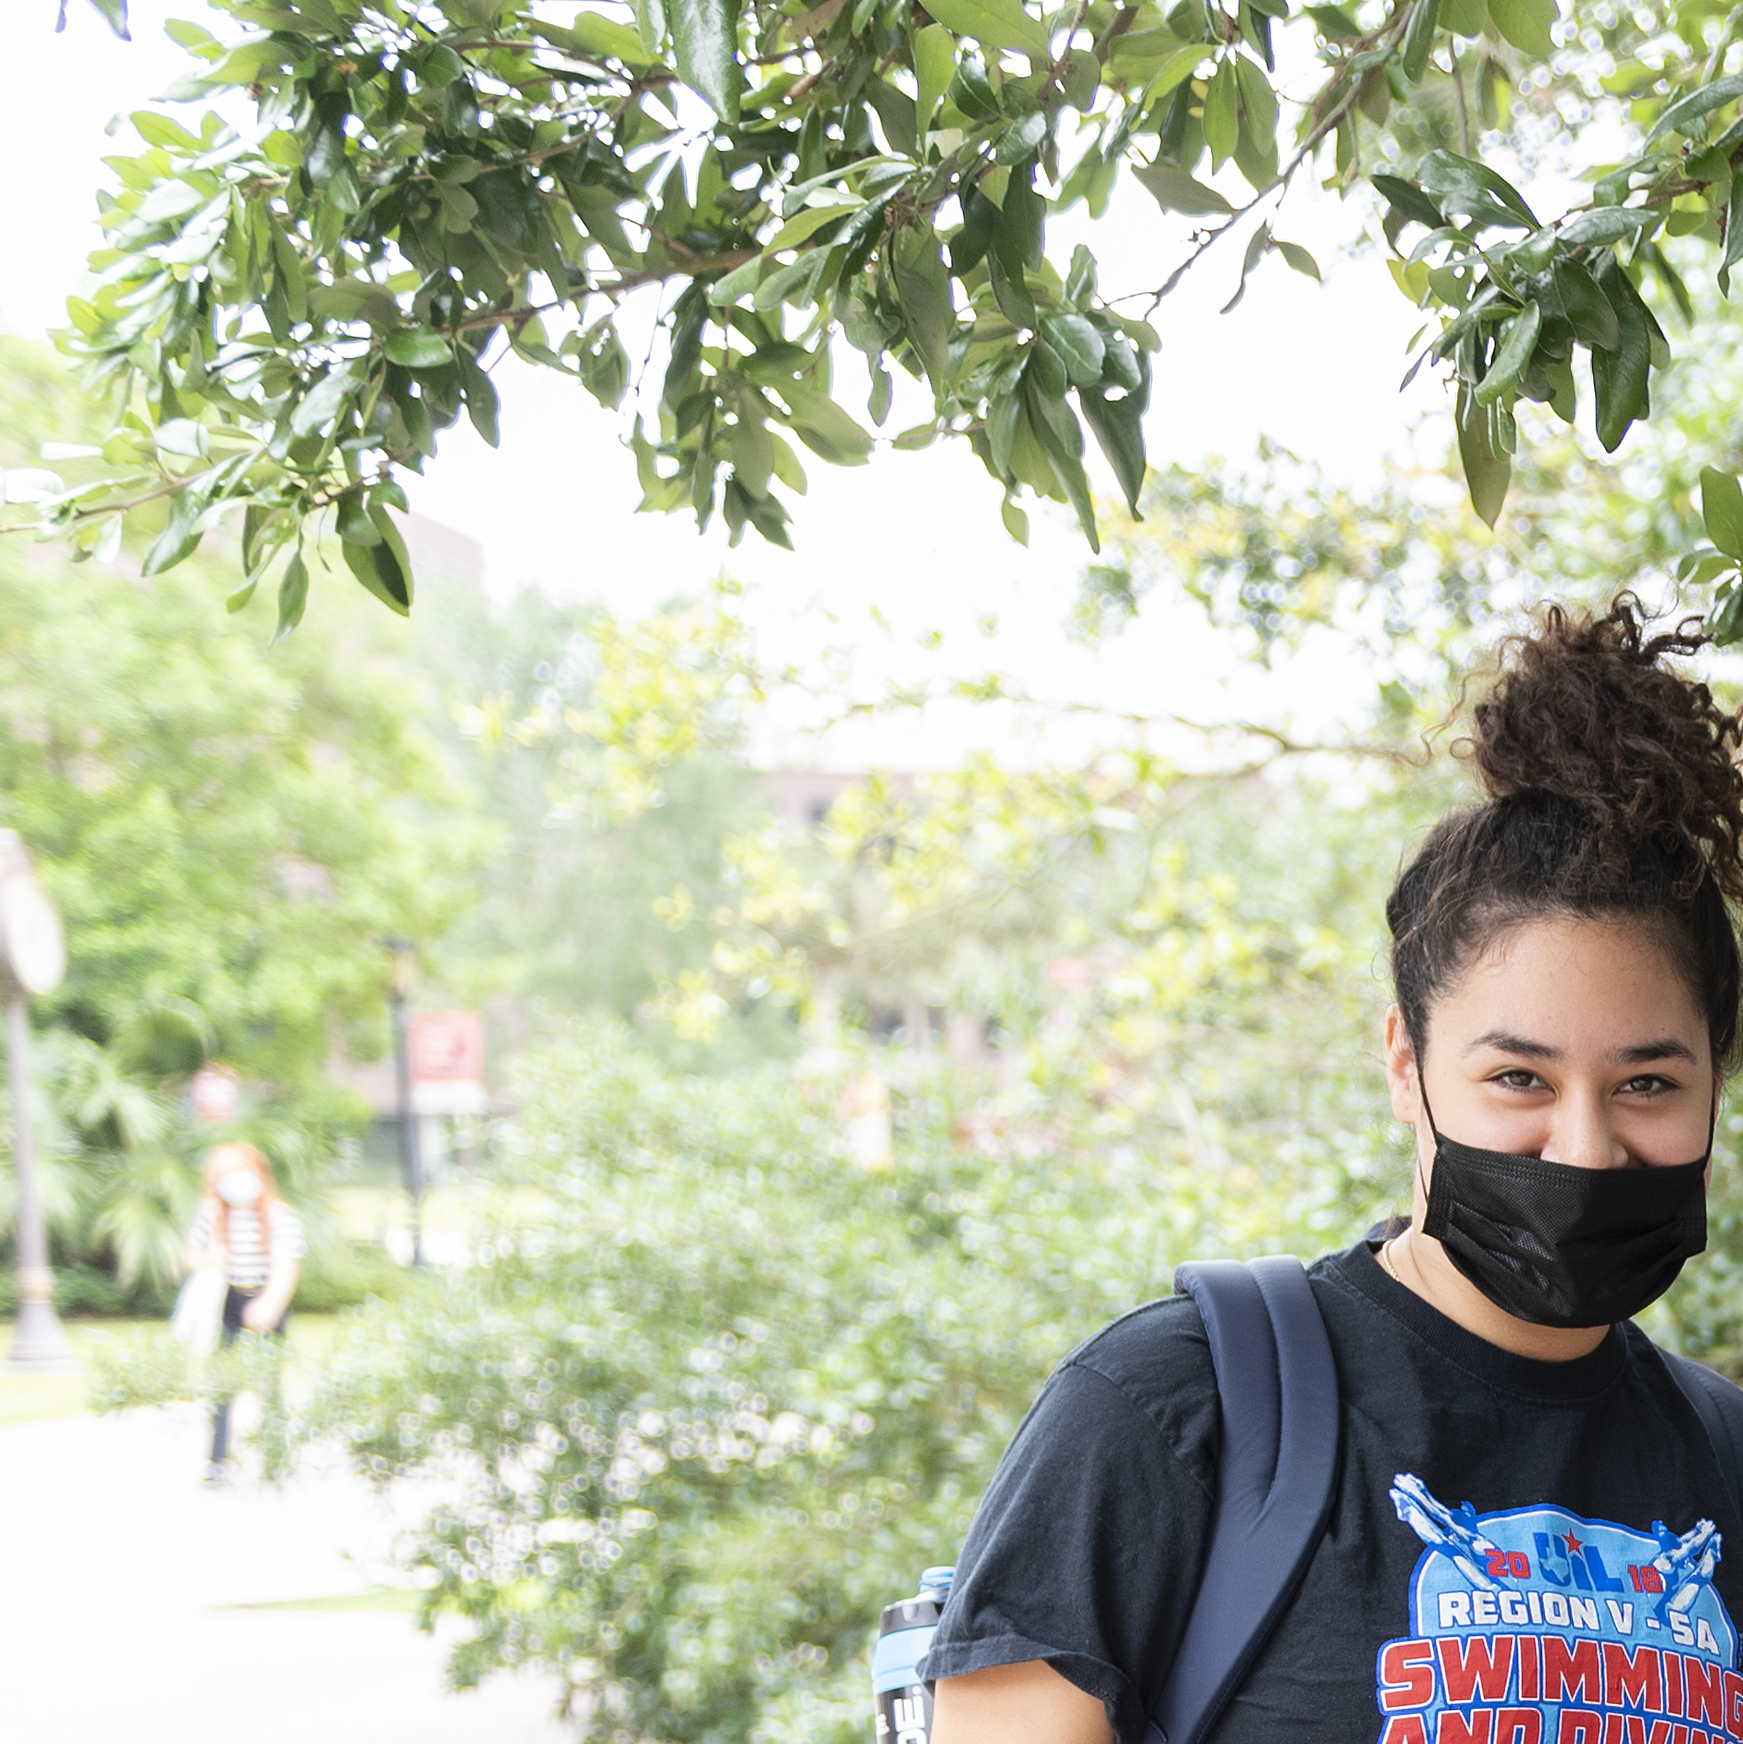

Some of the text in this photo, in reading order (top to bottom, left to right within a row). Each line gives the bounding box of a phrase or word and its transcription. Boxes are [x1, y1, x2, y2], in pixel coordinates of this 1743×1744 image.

[1485, 1549, 1531, 1579] 20
[1627, 1564, 1663, 1593] 18
[1439, 1592, 1598, 1630] REGION
[1600, 1600, 1634, 1634] V
[1669, 1610, 1719, 1656] SA
